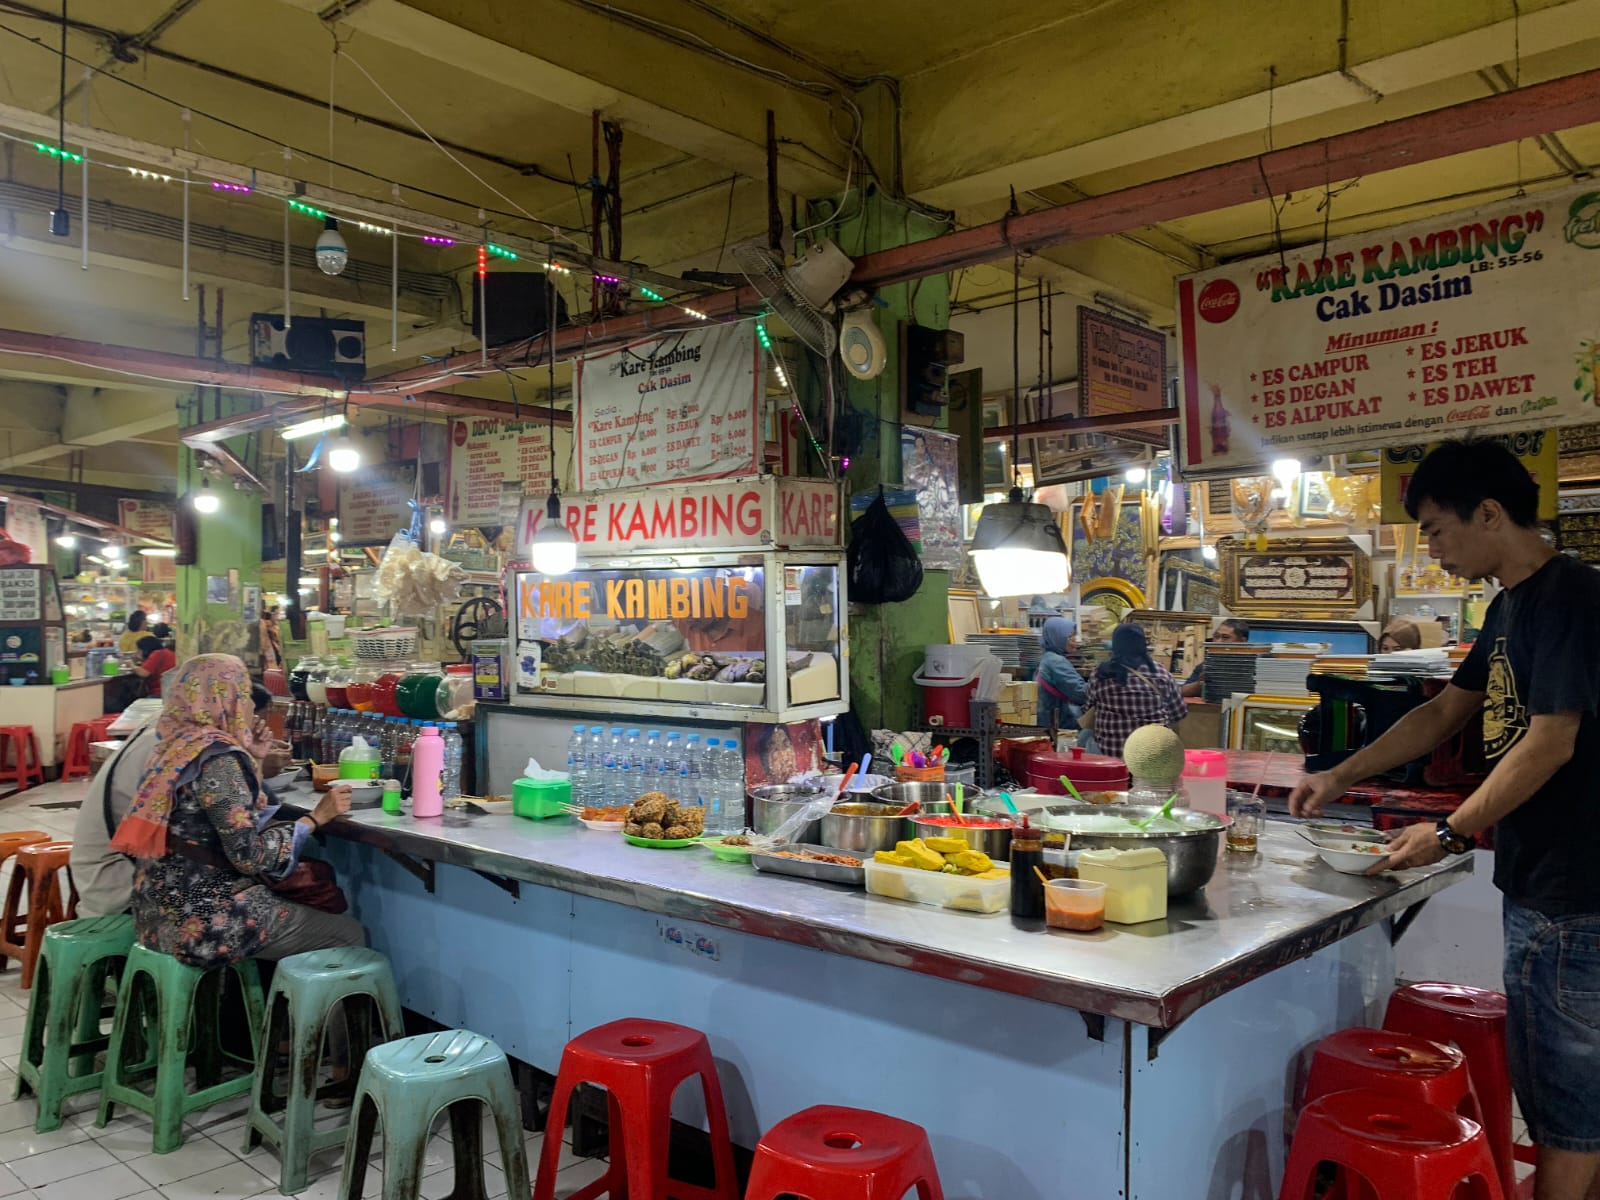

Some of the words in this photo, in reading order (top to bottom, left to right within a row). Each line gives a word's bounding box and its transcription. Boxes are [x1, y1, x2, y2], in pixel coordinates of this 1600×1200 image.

[1470, 261, 1495, 274] LB:
[1498, 250, 1544, 268] 55-56
[1316, 290, 1372, 321] Cak
[1378, 273, 1473, 312] Dasim
[1325, 322, 1427, 353] Minuman
[1421, 341, 1447, 361] ES
[1452, 326, 1529, 356] JERUK
[620, 359, 647, 377] Kare
[660, 373, 692, 390] Dasim
[1263, 368, 1285, 386] ES
[1288, 354, 1370, 382] CAMPUR
[1422, 364, 1448, 383] ES
[1452, 356, 1498, 379] TEH
[1264, 390, 1286, 407] ES
[1290, 378, 1356, 403] DEGAN
[1423, 387, 1449, 406] ES
[1454, 374, 1536, 402] DAWET
[472, 418, 499, 437] DEPOT
[1265, 411, 1287, 428] ES
[1290, 396, 1383, 425] ALPUKAT
[1297, 431, 1329, 441] santap
[1331, 424, 1355, 437] lebih
[1357, 420, 1402, 433] istimewa
[1404, 414, 1444, 428] dengan
[1495, 406, 1518, 417] dan
[525, 504, 598, 545] KRE
[607, 491, 763, 541] KAMBING
[781, 490, 836, 537] KARE
[521, 580, 591, 619] KARE
[607, 577, 748, 620] KAMBING
